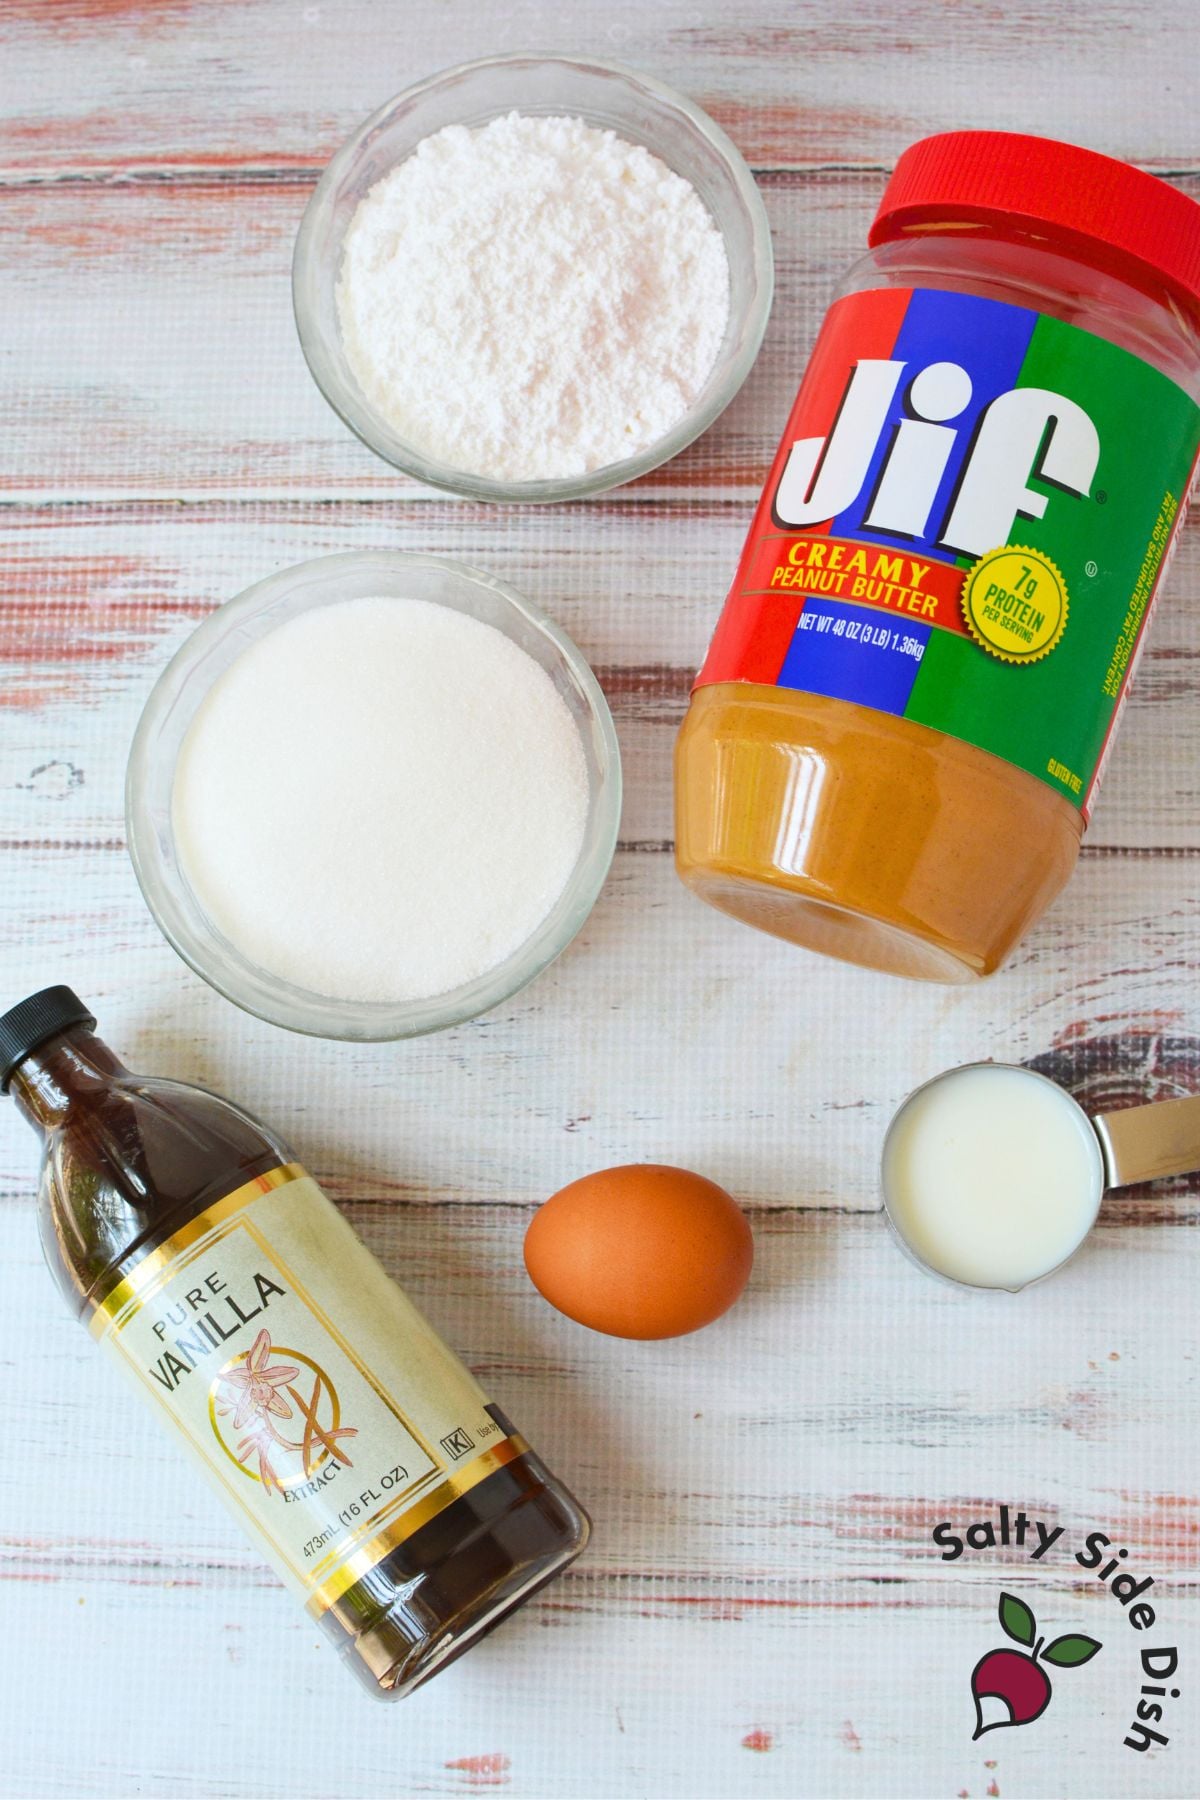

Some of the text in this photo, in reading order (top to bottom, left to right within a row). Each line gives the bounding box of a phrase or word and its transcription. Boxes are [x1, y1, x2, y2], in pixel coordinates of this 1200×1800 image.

[771, 359, 1100, 560] Jif
[1152, 513, 1164, 541] AND
[1161, 491, 1173, 515] FAT
[788, 542, 931, 589] CREAMY
[1014, 565, 1038, 600] 7g
[1130, 541, 1156, 611] SATURATED
[771, 567, 938, 618] PEANUT BUTTER
[984, 583, 1045, 632] PROTEIN
[1110, 499, 1178, 698] SEE NUTRITION INFORMATION FOR
[797, 613, 925, 662] NET WT 48 OZ (3 LB) 1.36kg
[982, 605, 1034, 644] PER SERVING
[1122, 611, 1133, 635] FAT
[152, 1271, 227, 1342] PURE
[148, 1273, 286, 1392] VANILLA
[283, 1459, 341, 1503] EXTRACT
[302, 1465, 409, 1558] 473mL (16 FL OZ)
